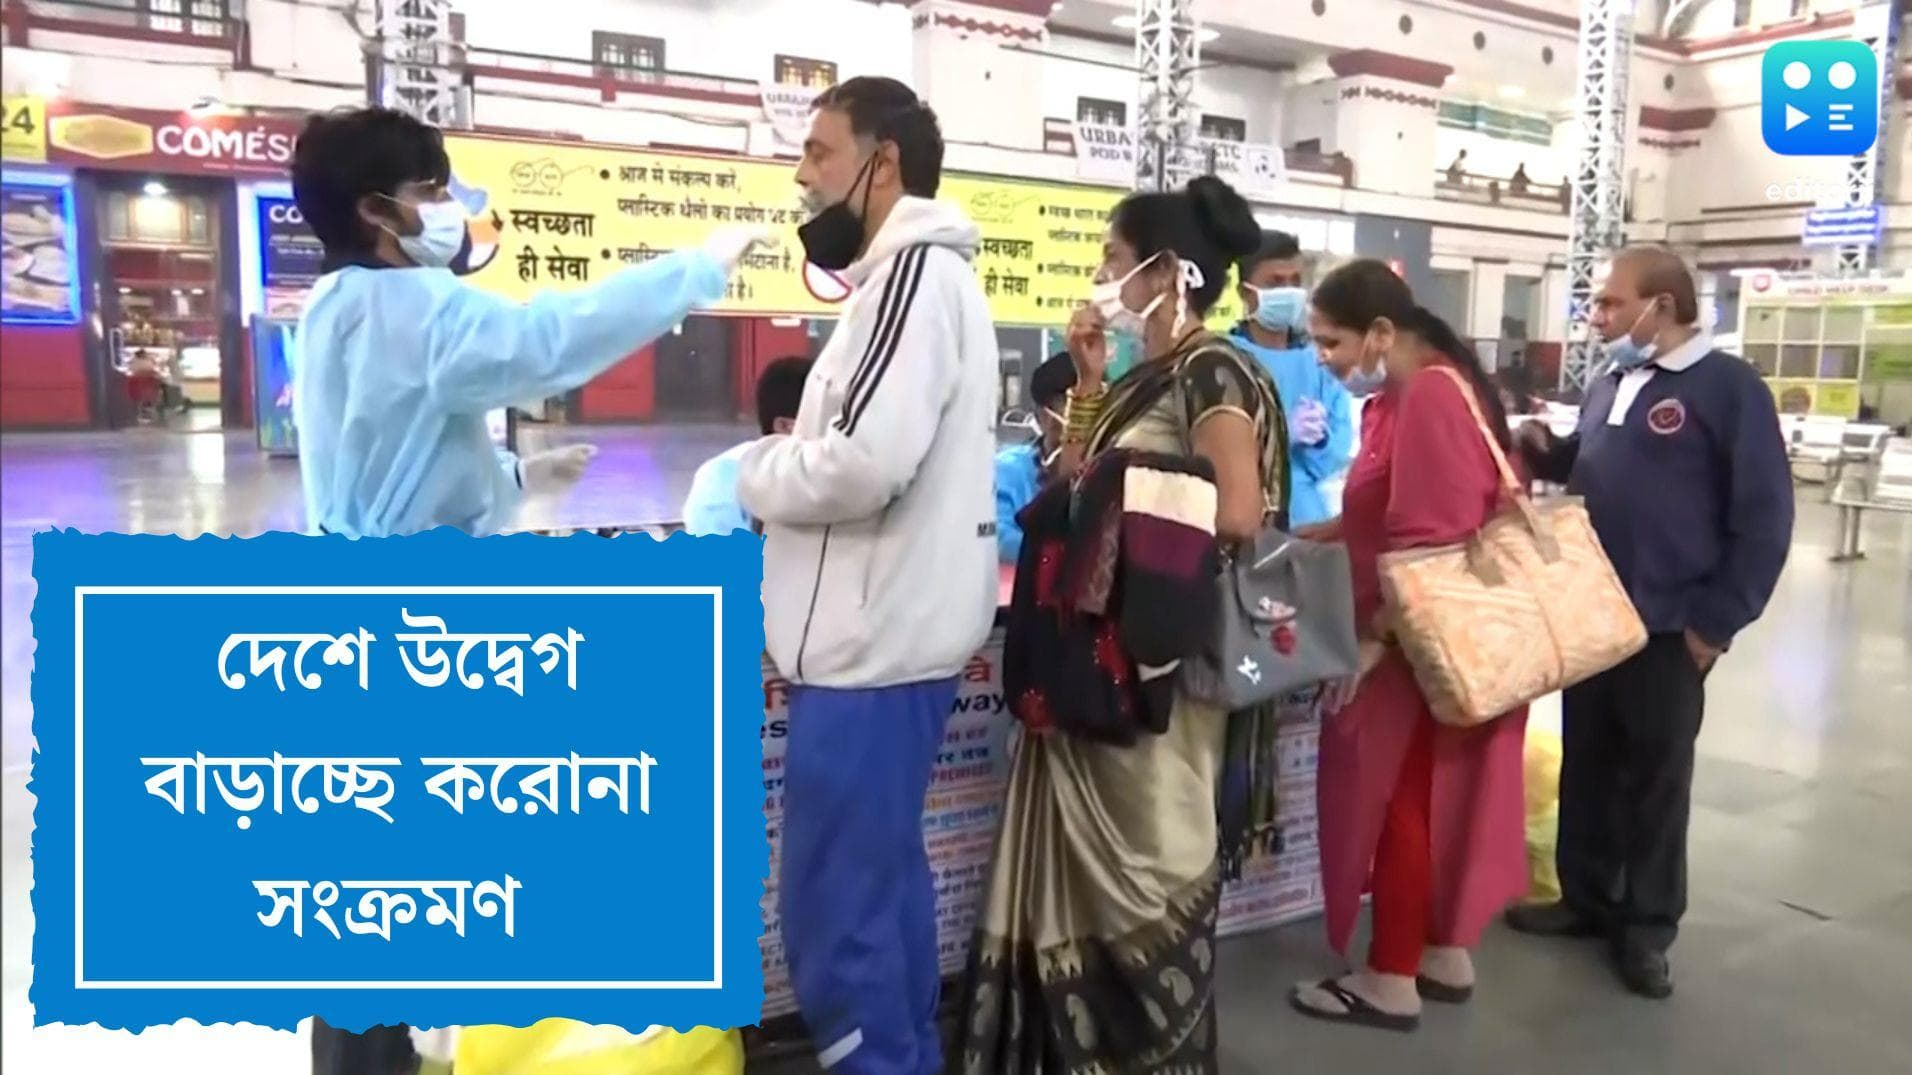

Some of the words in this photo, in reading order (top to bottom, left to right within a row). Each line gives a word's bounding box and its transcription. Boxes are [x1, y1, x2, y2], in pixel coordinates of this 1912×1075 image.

[157, 125, 297, 162] COMÉS
[1080, 127, 1132, 146] URBA
[510, 209, 595, 238] स्वच्छता
[982, 237, 1033, 260] स्वच्छता
[516, 245, 539, 282] ही
[545, 245, 590, 281] सेवा
[1001, 267, 1029, 295] सेवा
